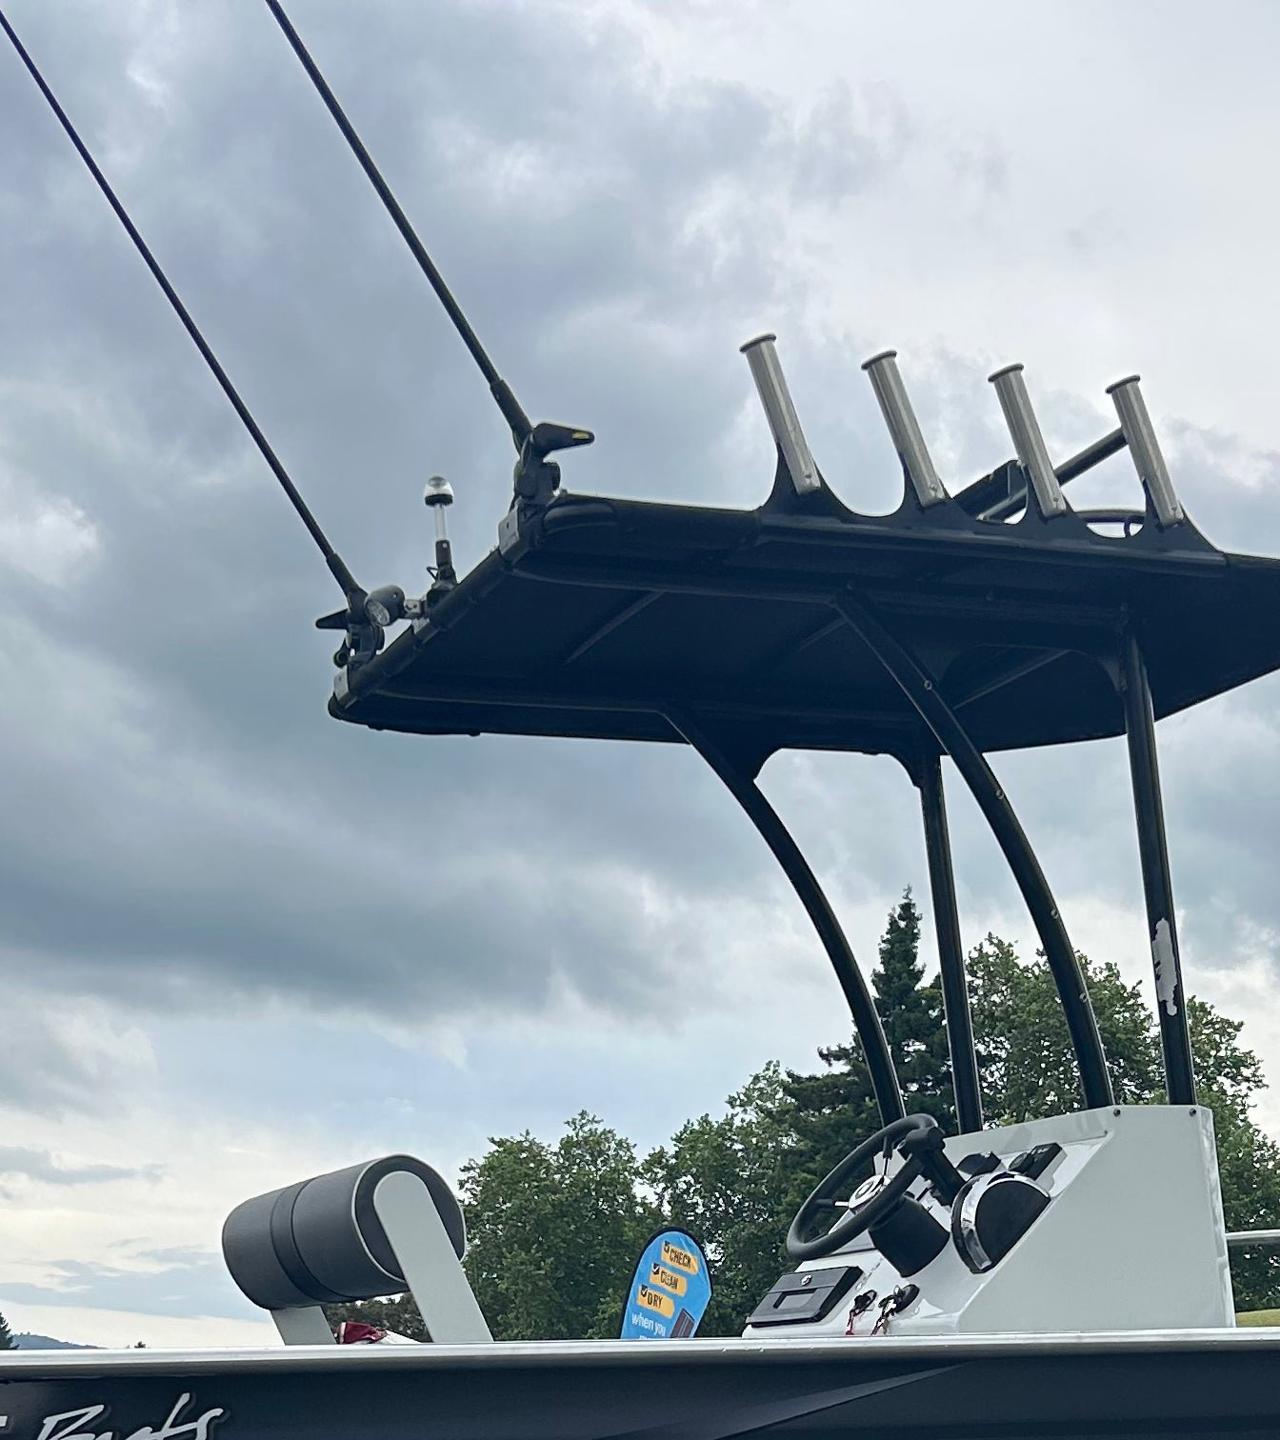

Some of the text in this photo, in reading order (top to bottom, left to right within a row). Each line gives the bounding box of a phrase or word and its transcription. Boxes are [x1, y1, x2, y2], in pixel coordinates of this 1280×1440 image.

[669, 1248, 691, 1269] CHECK
[660, 1269, 679, 1290] CLEAN
[647, 1293, 663, 1309] DRY
[631, 1312, 654, 1331] when
